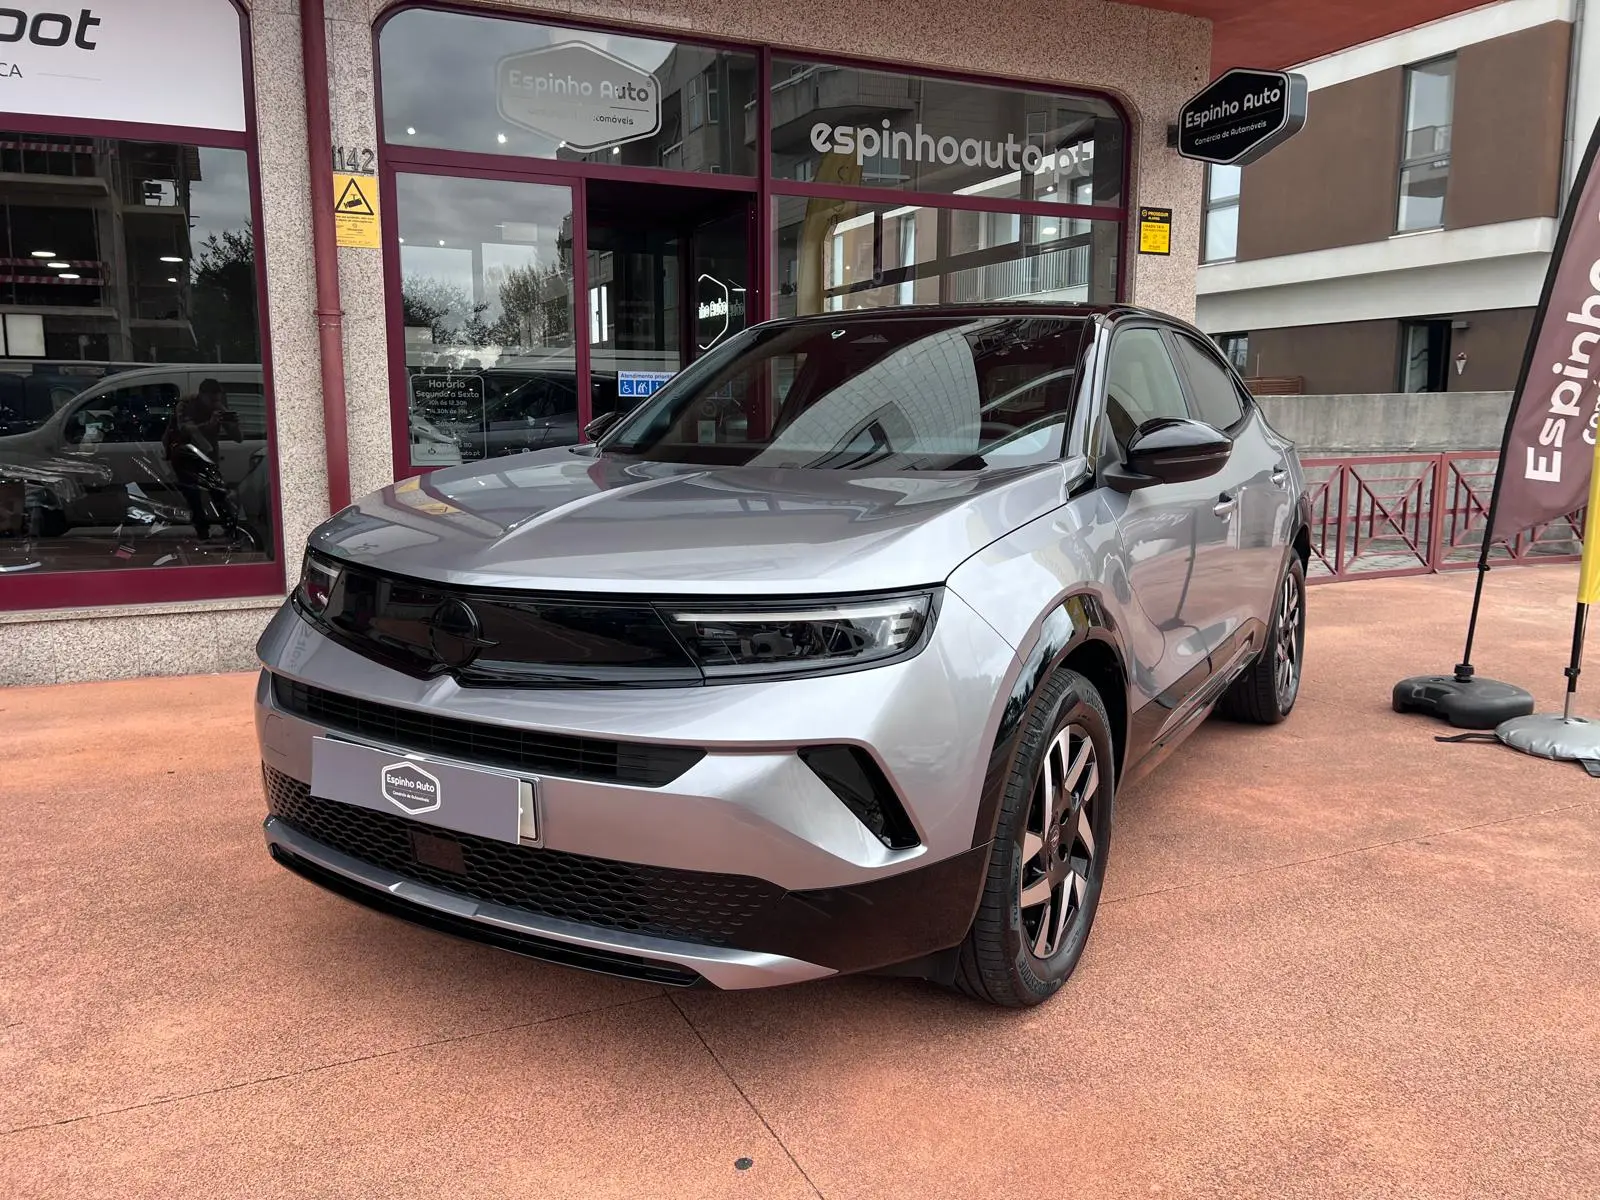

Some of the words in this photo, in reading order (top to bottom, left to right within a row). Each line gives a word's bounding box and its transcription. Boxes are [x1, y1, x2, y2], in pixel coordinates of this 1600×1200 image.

[509, 70, 593, 98] Espinho
[600, 81, 650, 102] Auto
[1186, 101, 1239, 128] Espinho
[1244, 88, 1280, 111] Auto
[1230, 119, 1267, 136] Automóveis
[810, 119, 1091, 182] espinhoauto.pt
[428, 379, 466, 388] Horário
[415, 390, 449, 399] Segunda
[386, 773, 415, 788] Espinho
[416, 781, 435, 792] Auto
